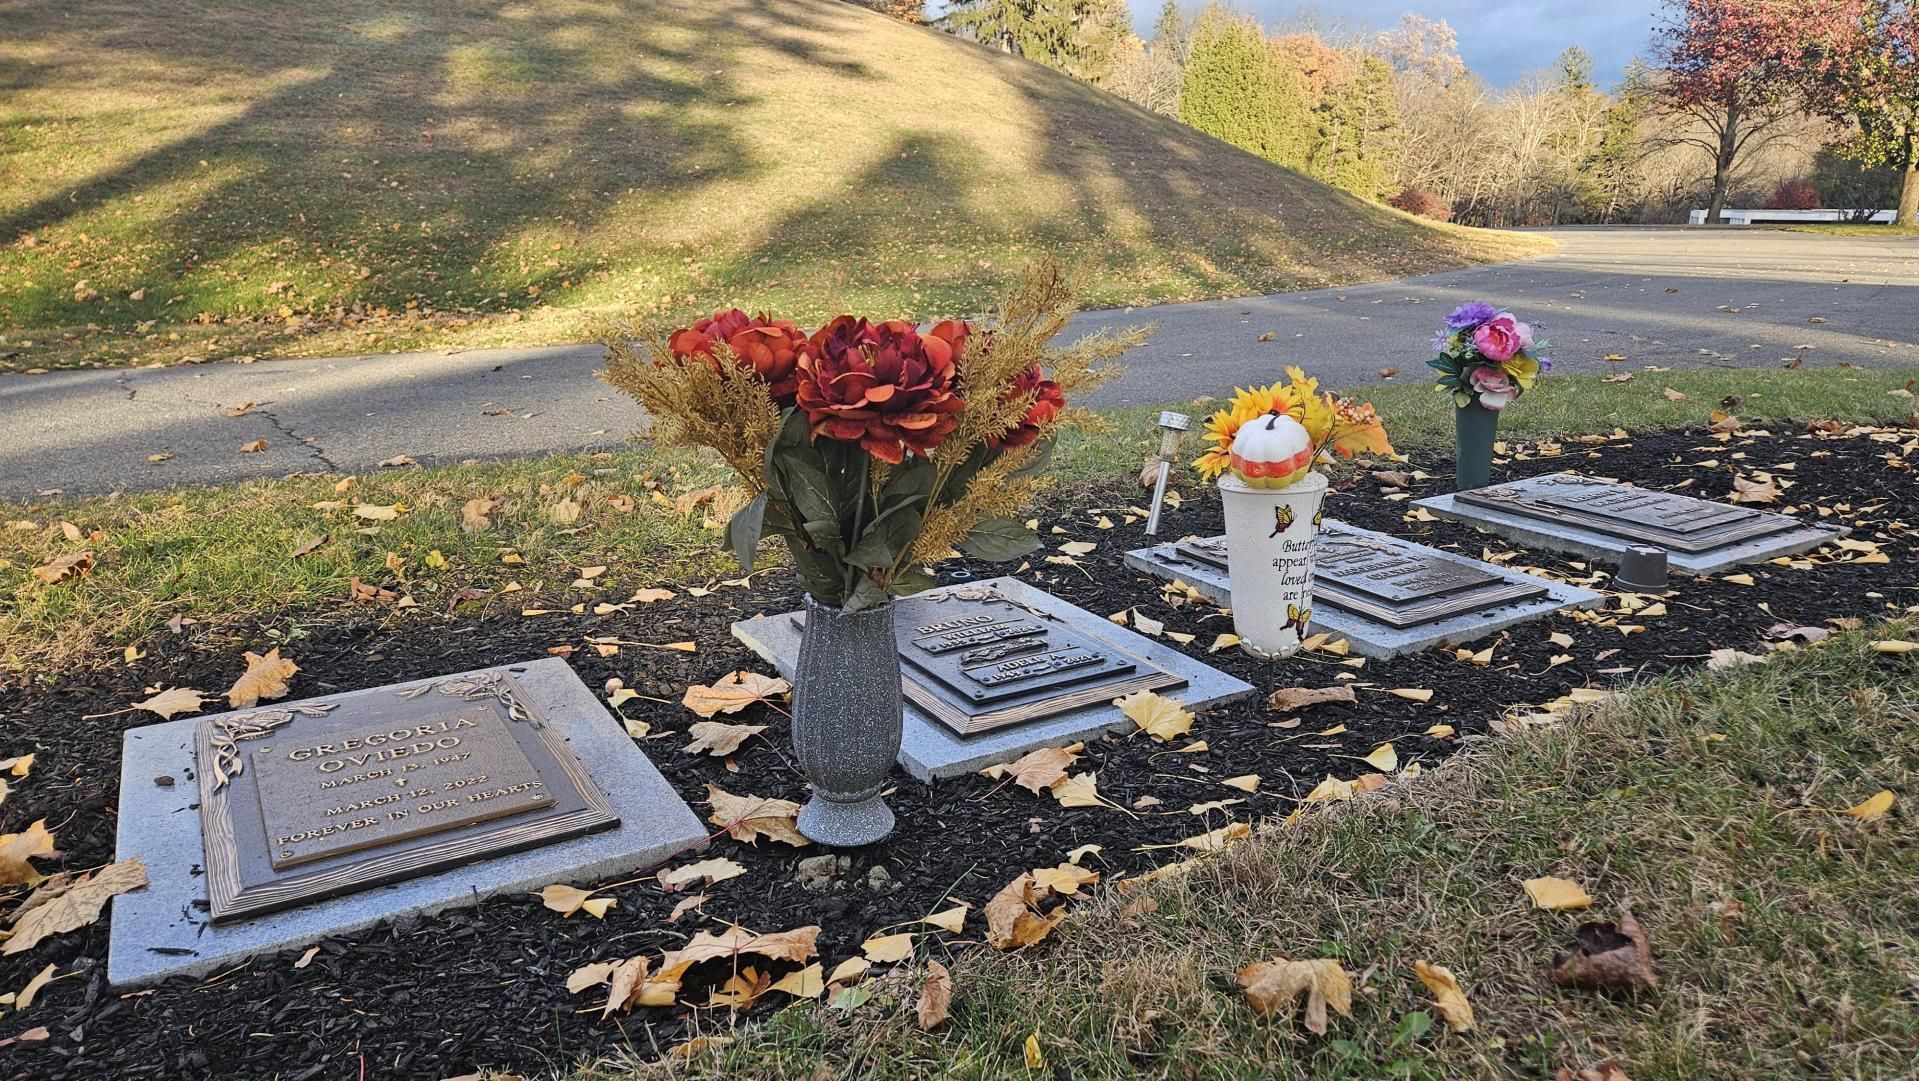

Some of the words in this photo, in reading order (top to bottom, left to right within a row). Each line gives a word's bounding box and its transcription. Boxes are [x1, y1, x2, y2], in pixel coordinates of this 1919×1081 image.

[1281, 570, 1308, 585] loved
[1282, 591, 1299, 601] are
[915, 615, 994, 634] BRUNO
[997, 656, 1044, 672] ADELE
[287, 716, 477, 762] GREGORIA
[318, 736, 462, 773] OVIEDO
[320, 768, 392, 790] MARCH
[433, 751, 472, 766] 1947
[277, 815, 378, 846] FOREVER
[388, 808, 410, 821] IN
[417, 799, 458, 814] OUR
[468, 779, 543, 802] HEARTS
[325, 793, 401, 816] MARCH
[444, 775, 489, 791] 2022
